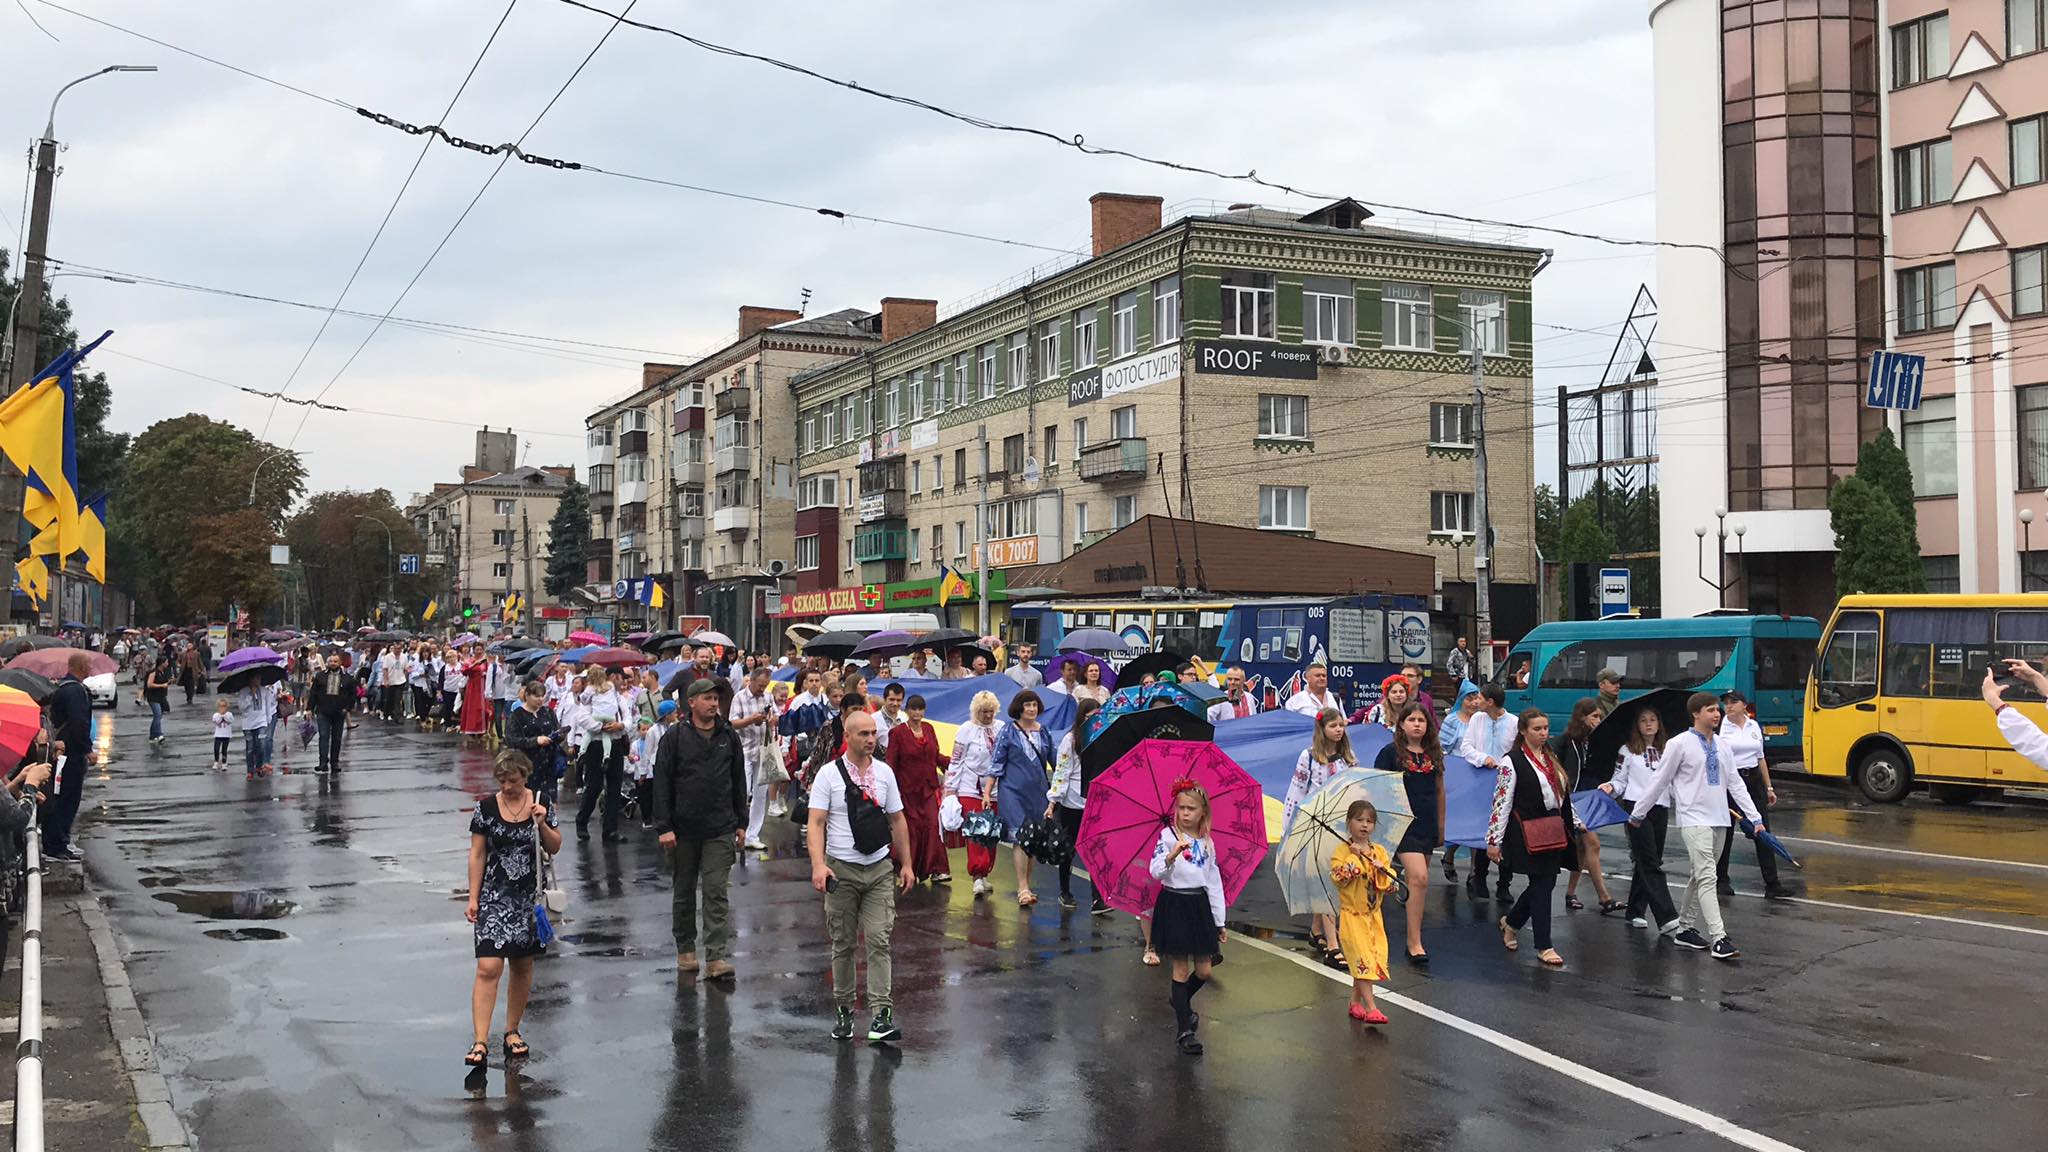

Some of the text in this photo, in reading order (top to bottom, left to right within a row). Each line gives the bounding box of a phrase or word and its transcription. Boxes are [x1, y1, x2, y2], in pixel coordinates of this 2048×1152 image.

[1387, 286, 1422, 299] ІНША
[1204, 347, 1263, 371] ROOF
[1277, 352, 1311, 362] поверх
[1105, 351, 1179, 390] ФОТОСТУДІЯ
[1071, 375, 1099, 401] ROOF
[974, 540, 1035, 565] ТКСІ 7007
[792, 593, 828, 614] СЕКОНД
[829, 590, 857, 611] ХЕНД
[1308, 606, 1325, 618] 005
[1331, 665, 1354, 678] 005
